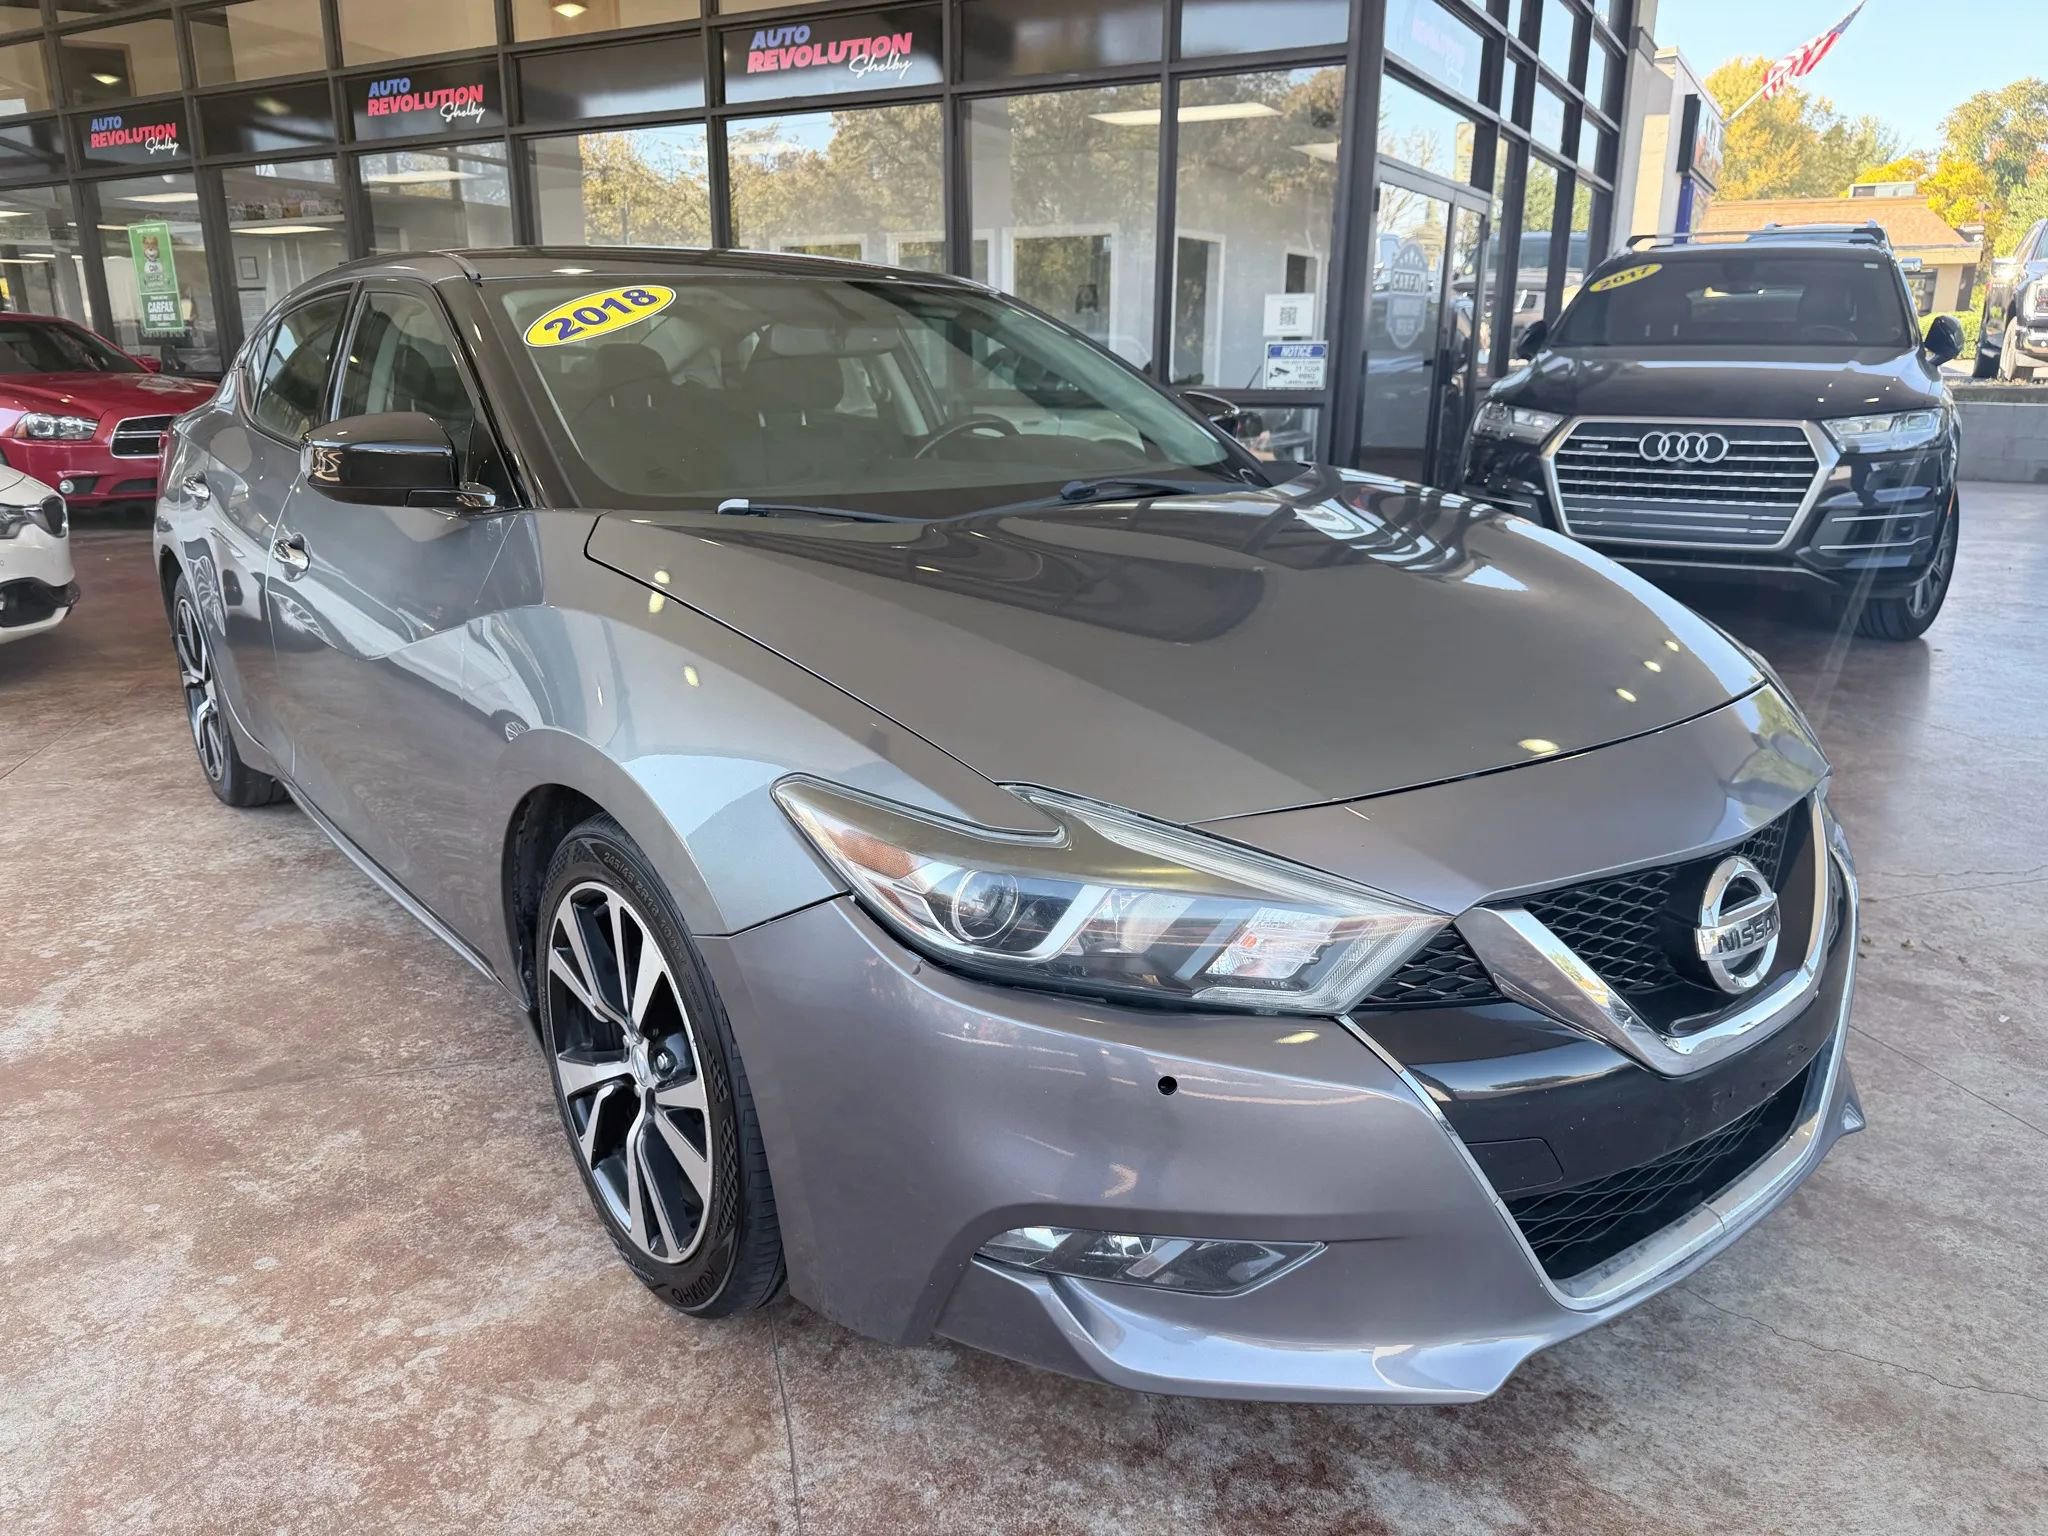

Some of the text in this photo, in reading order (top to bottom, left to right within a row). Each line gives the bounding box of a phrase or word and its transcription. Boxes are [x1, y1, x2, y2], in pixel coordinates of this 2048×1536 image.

[750, 25, 810, 49] AUTO
[747, 32, 913, 73] REVOLUTION
[849, 49, 913, 80] Shelby
[368, 77, 411, 97] AUTO
[367, 84, 484, 117] REVOLUTION
[440, 98, 486, 124] Shelby
[91, 115, 122, 132] AUTO
[91, 122, 176, 148] REVOLUTION
[145, 134, 179, 156] Shelby
[1600, 266, 1650, 290] 2017
[147, 300, 174, 313] CARFAX
[544, 289, 661, 341] 2018
[1280, 345, 1312, 357] NOTICE
